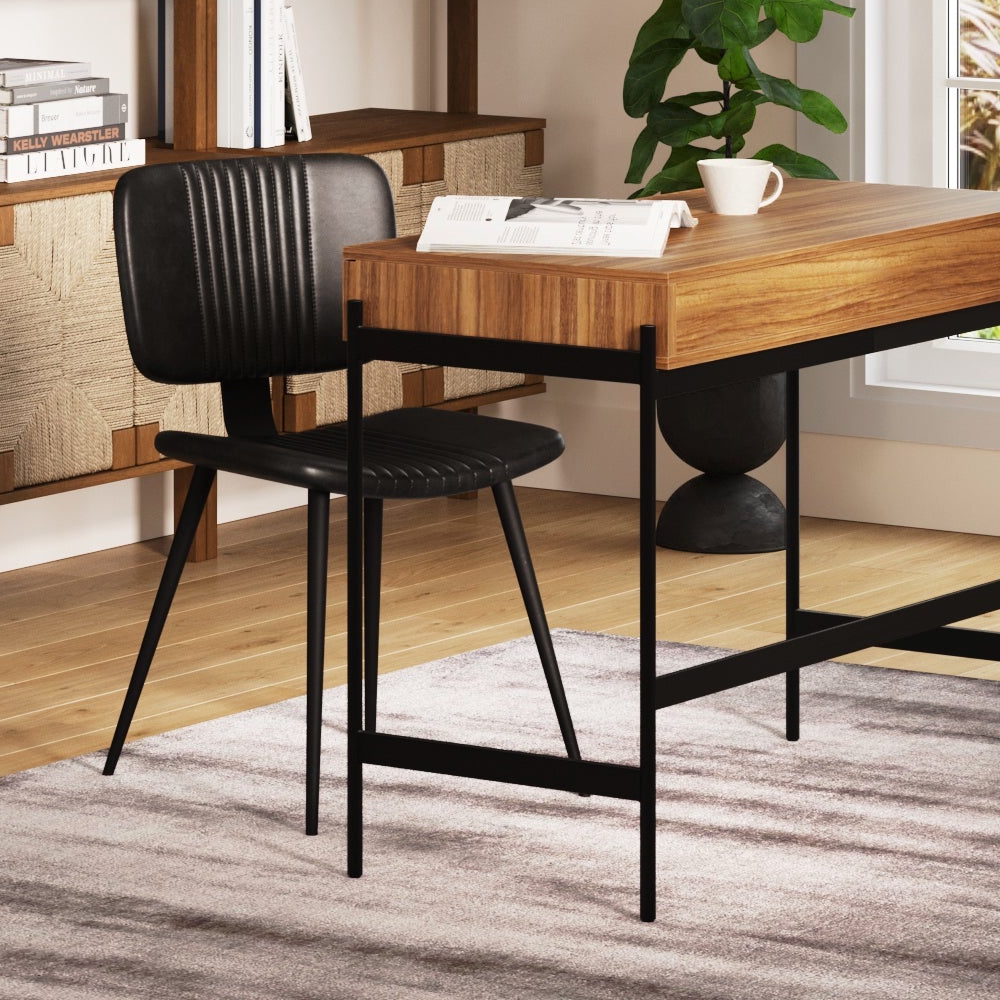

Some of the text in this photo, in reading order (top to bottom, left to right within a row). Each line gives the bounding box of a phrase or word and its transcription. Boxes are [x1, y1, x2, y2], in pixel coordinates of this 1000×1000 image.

[24, 69, 66, 82] MINIMAL
[74, 83, 97, 95] Nature
[13, 127, 120, 152] KELLY WEARSTLER
